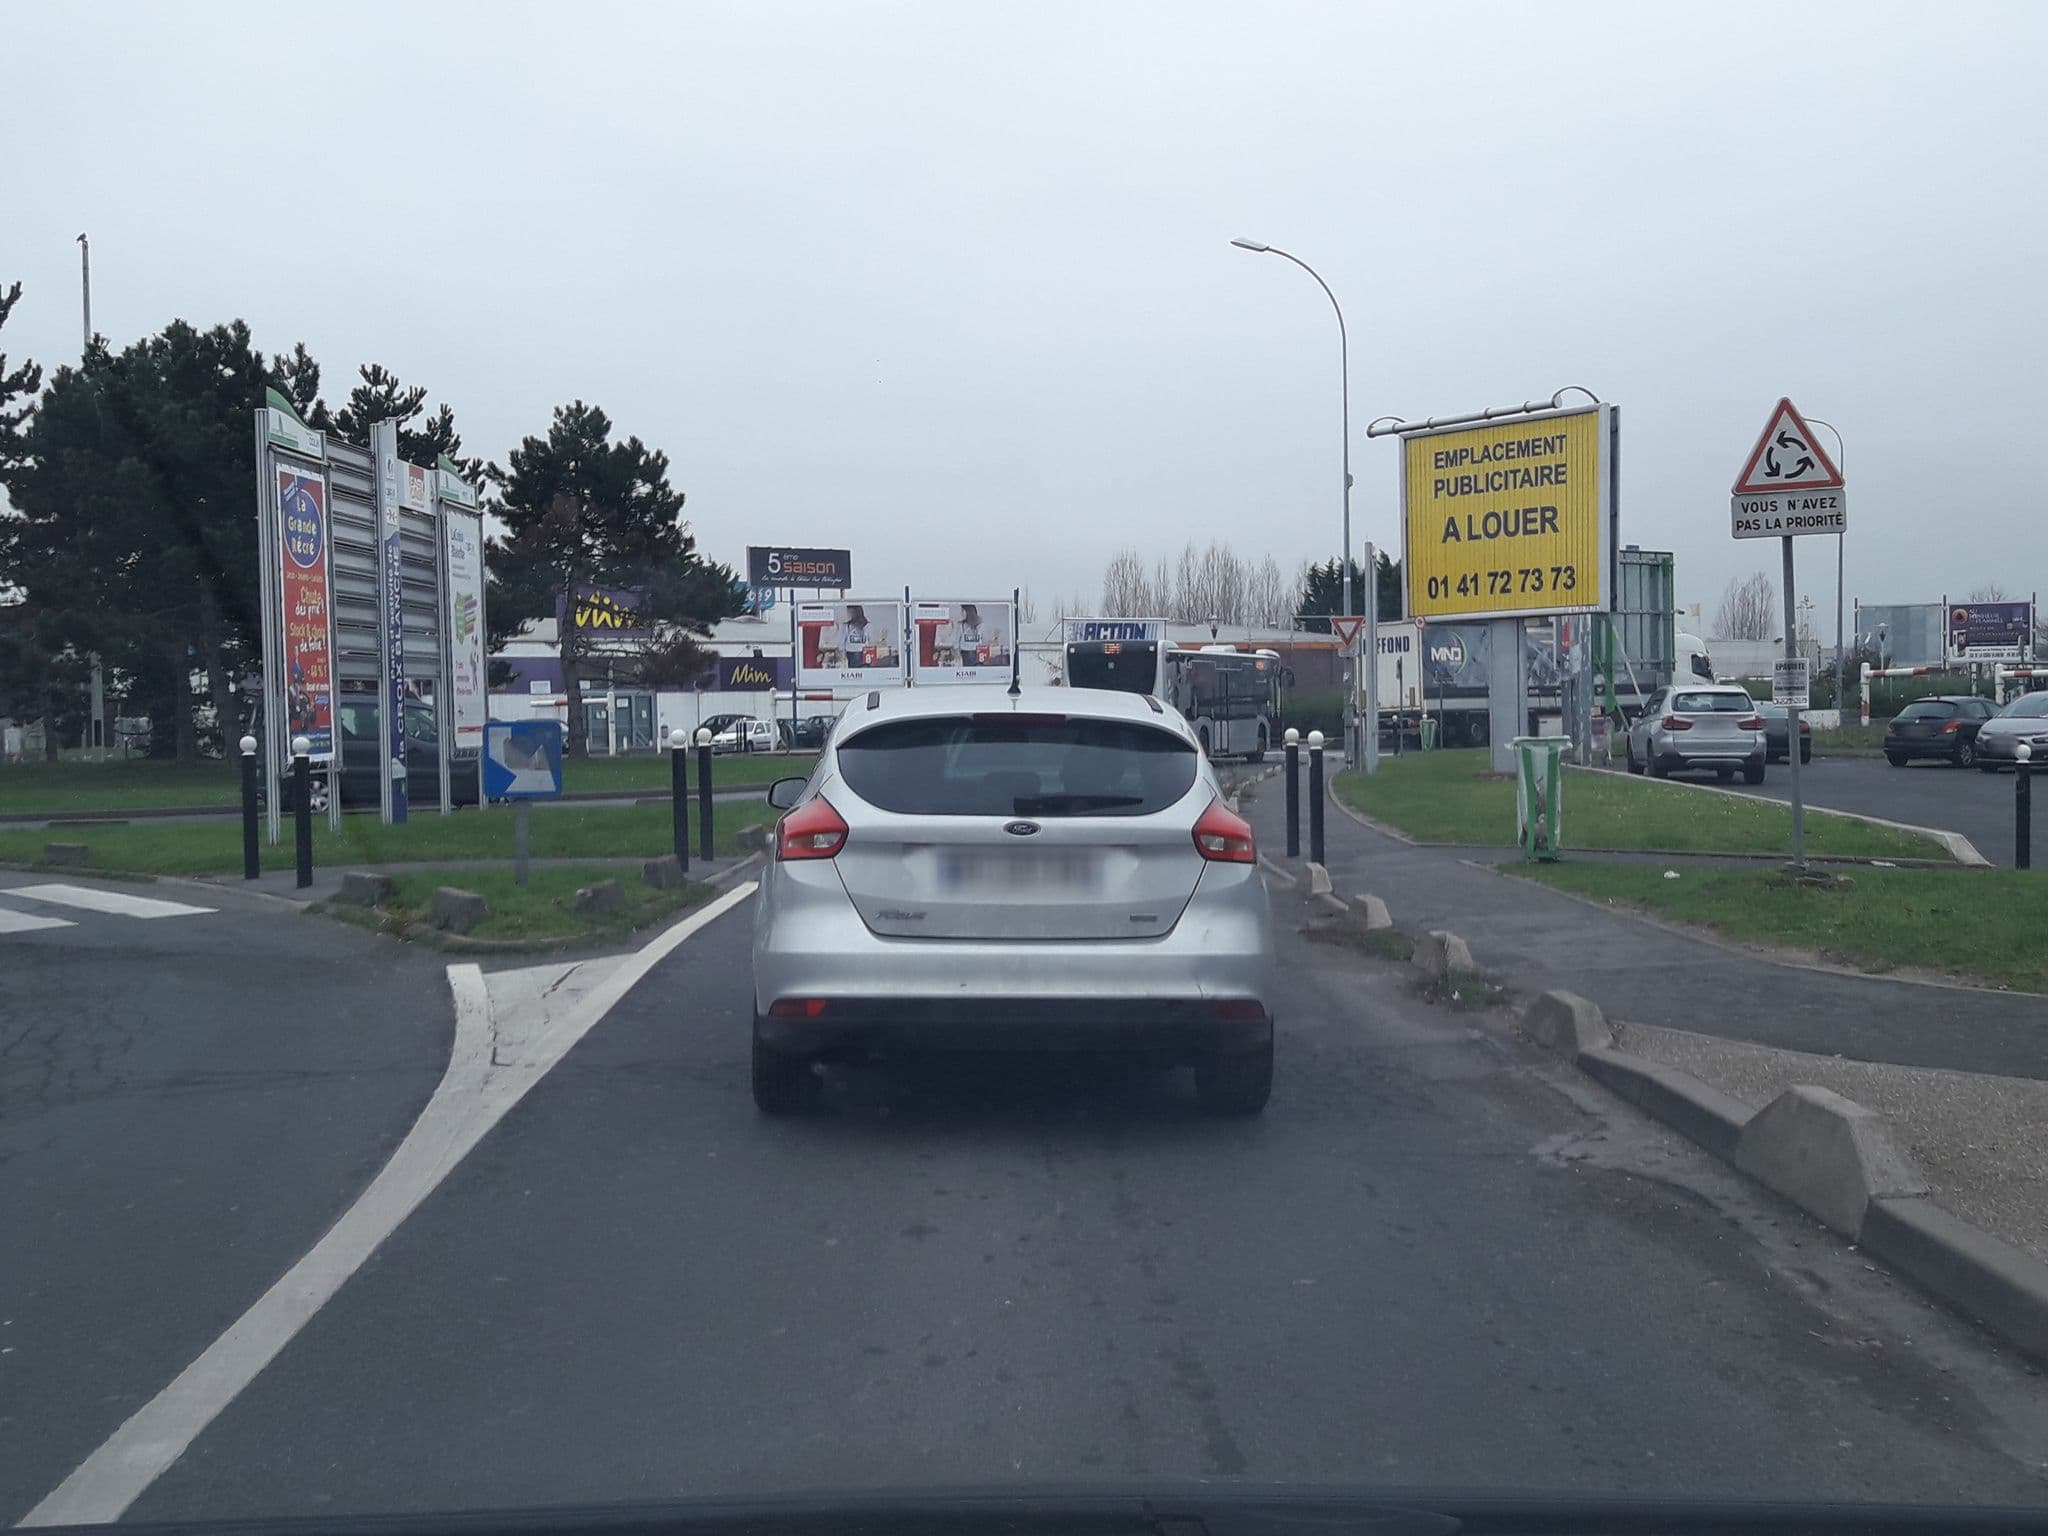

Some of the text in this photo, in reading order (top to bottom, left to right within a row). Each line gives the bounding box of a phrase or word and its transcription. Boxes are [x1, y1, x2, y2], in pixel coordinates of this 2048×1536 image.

[1434, 435, 1567, 470] EMPLACEMENT
[1434, 463, 1568, 499] PUBLICITAIRE
[296, 495, 306, 512] La
[1741, 497, 1837, 513] VOUS N'AVEZ
[287, 515, 317, 536] Grande
[1442, 505, 1560, 543] A LOUER
[1736, 512, 1843, 531] PAS LA PRIORITÉ
[767, 553, 781, 574] 5
[783, 562, 835, 575] saison
[1427, 565, 1576, 600] 01 41 72 73 73
[393, 546, 402, 656] BLANCHE
[1084, 622, 1147, 640] ACTION
[730, 663, 772, 685] Mim
[395, 662, 405, 735] CROIX
